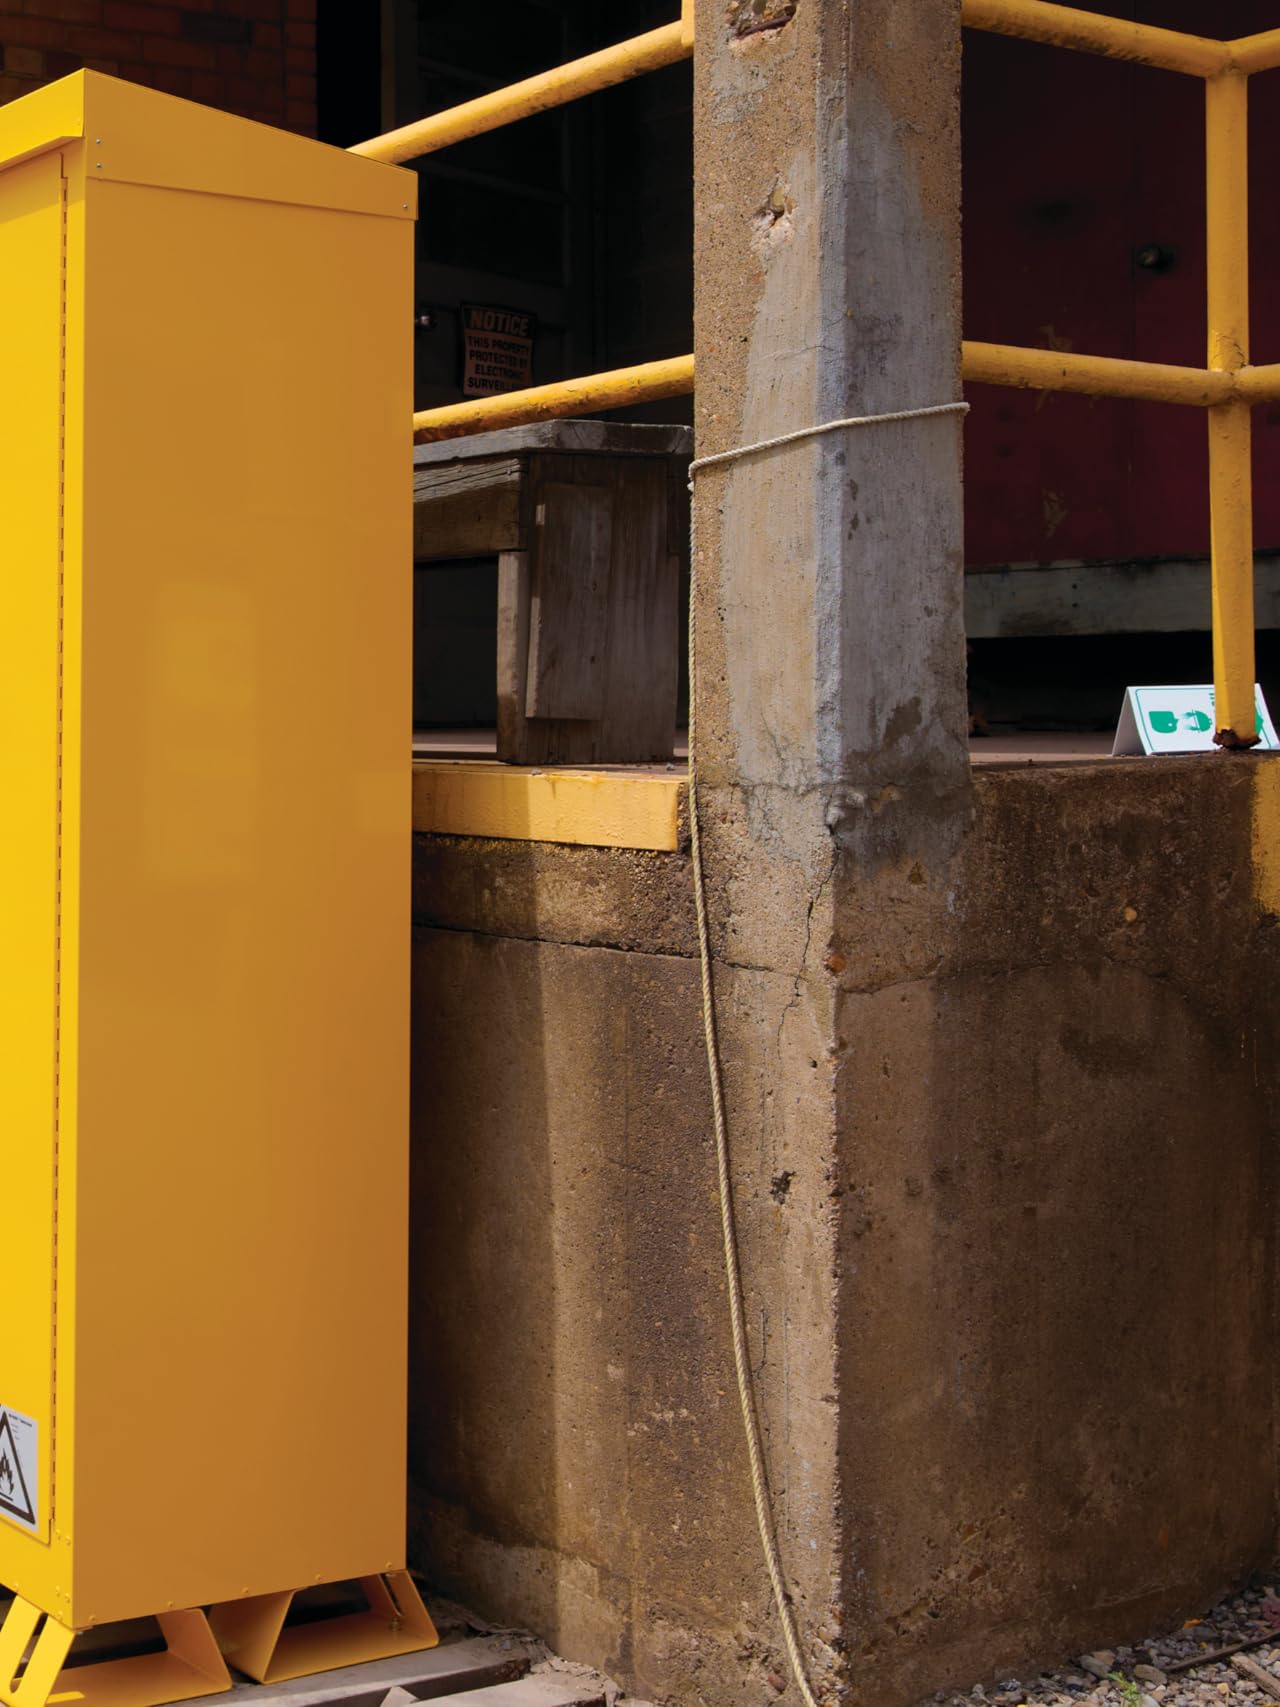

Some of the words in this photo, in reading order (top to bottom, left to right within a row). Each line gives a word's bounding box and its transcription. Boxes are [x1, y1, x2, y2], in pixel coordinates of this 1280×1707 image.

[468, 307, 529, 337] NOTICE
[468, 335, 490, 349] THIS
[469, 349, 517, 368] PROTECTED
